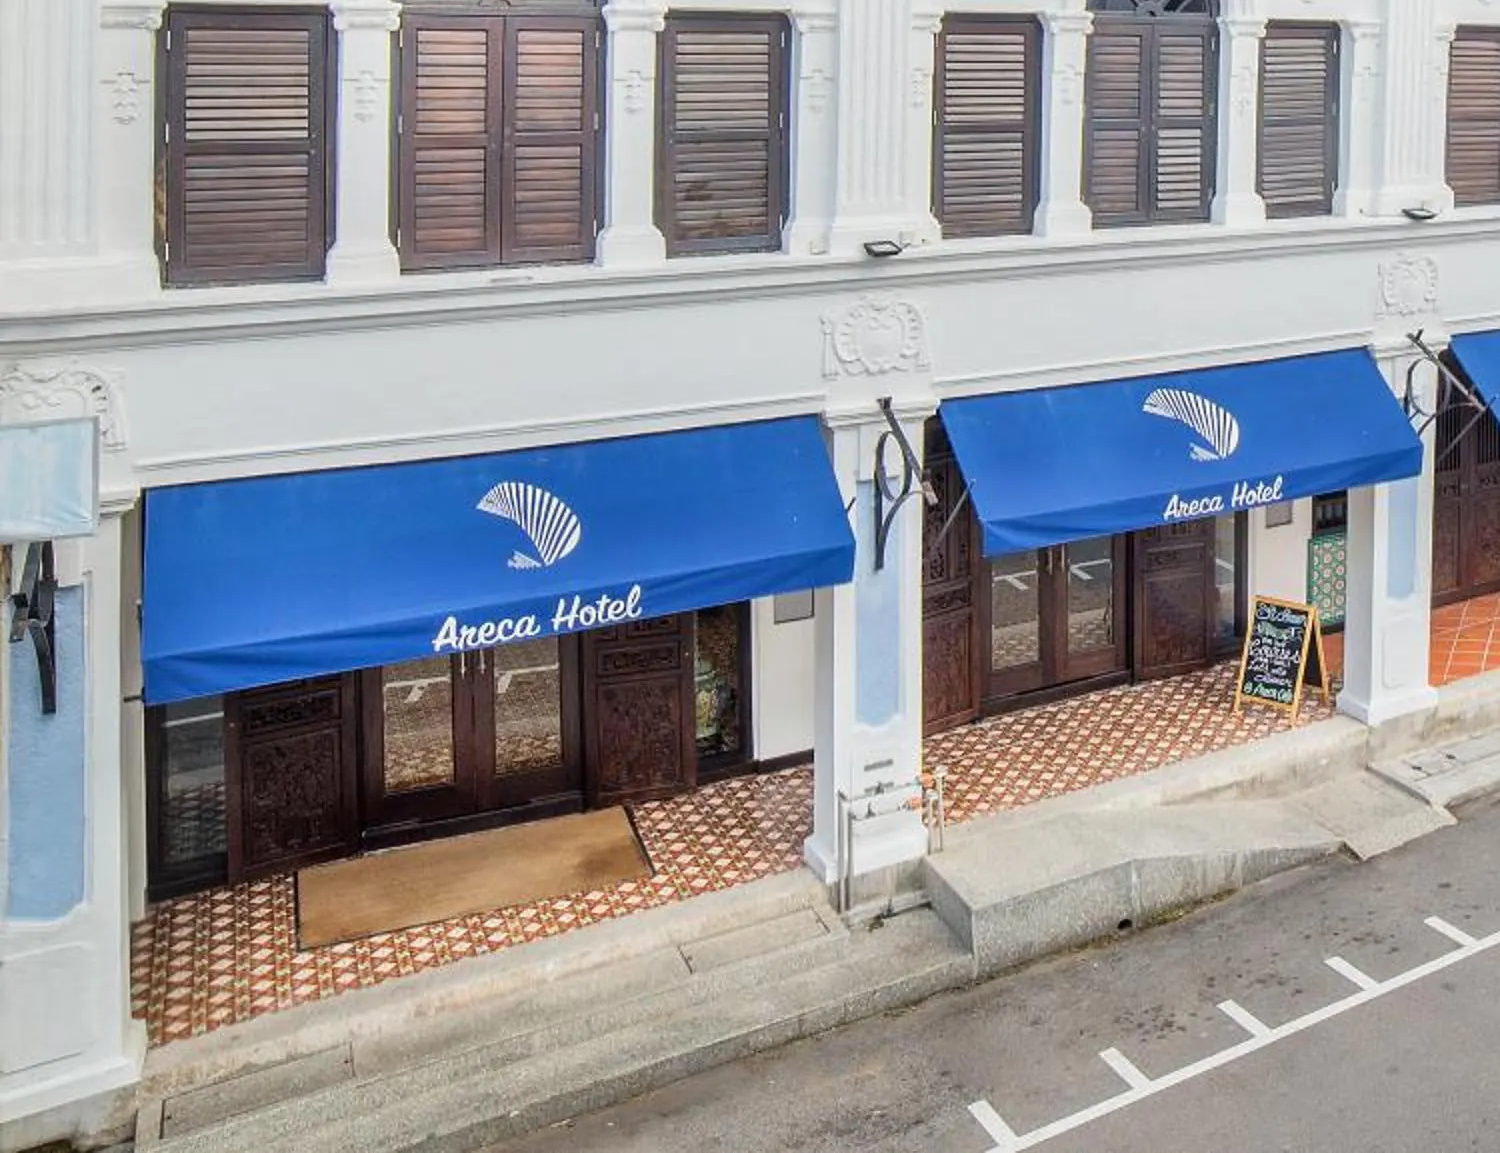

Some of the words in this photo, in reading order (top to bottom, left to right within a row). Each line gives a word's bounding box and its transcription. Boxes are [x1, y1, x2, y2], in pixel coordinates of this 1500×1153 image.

[1163, 494, 1224, 521] Areca
[1231, 474, 1283, 508] Hotel
[432, 615, 540, 652] Areca
[551, 583, 643, 631] Hotel
